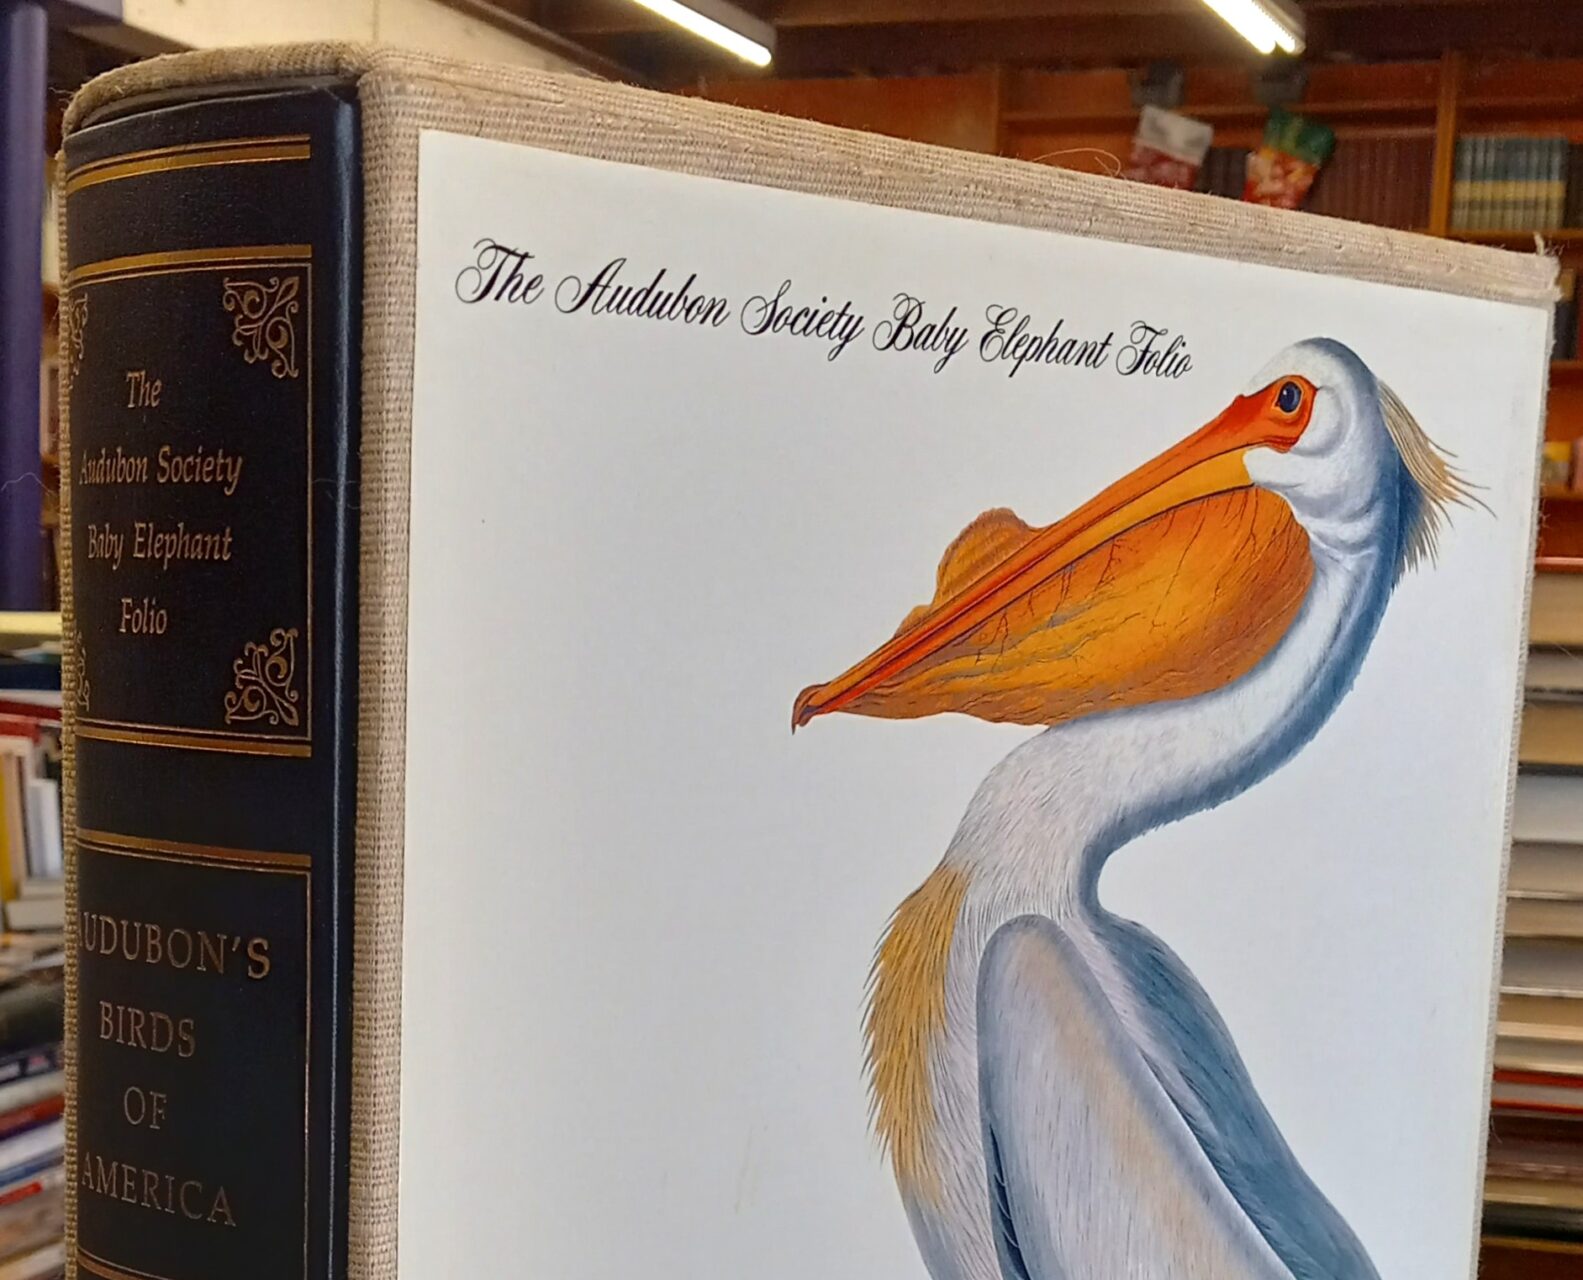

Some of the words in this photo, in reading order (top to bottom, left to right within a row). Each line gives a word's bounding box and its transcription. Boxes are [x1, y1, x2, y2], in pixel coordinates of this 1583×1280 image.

[455, 238, 544, 304] The
[555, 258, 731, 327] Audubon
[741, 279, 865, 361] Society
[872, 293, 969, 374] Baby
[980, 304, 1114, 378] Elephant
[1116, 320, 1192, 379] Folio
[126, 370, 162, 408] The
[79, 446, 148, 485] Audubon
[157, 445, 243, 496] Society
[88, 523, 124, 570] Baby
[133, 520, 232, 570] Elephant
[119, 597, 167, 635] Folio
[79, 911, 271, 979] UDUBON'S
[100, 1000, 196, 1057] BIRDS
[124, 1086, 167, 1130] OF
[81, 1151, 236, 1228] AMERICA
